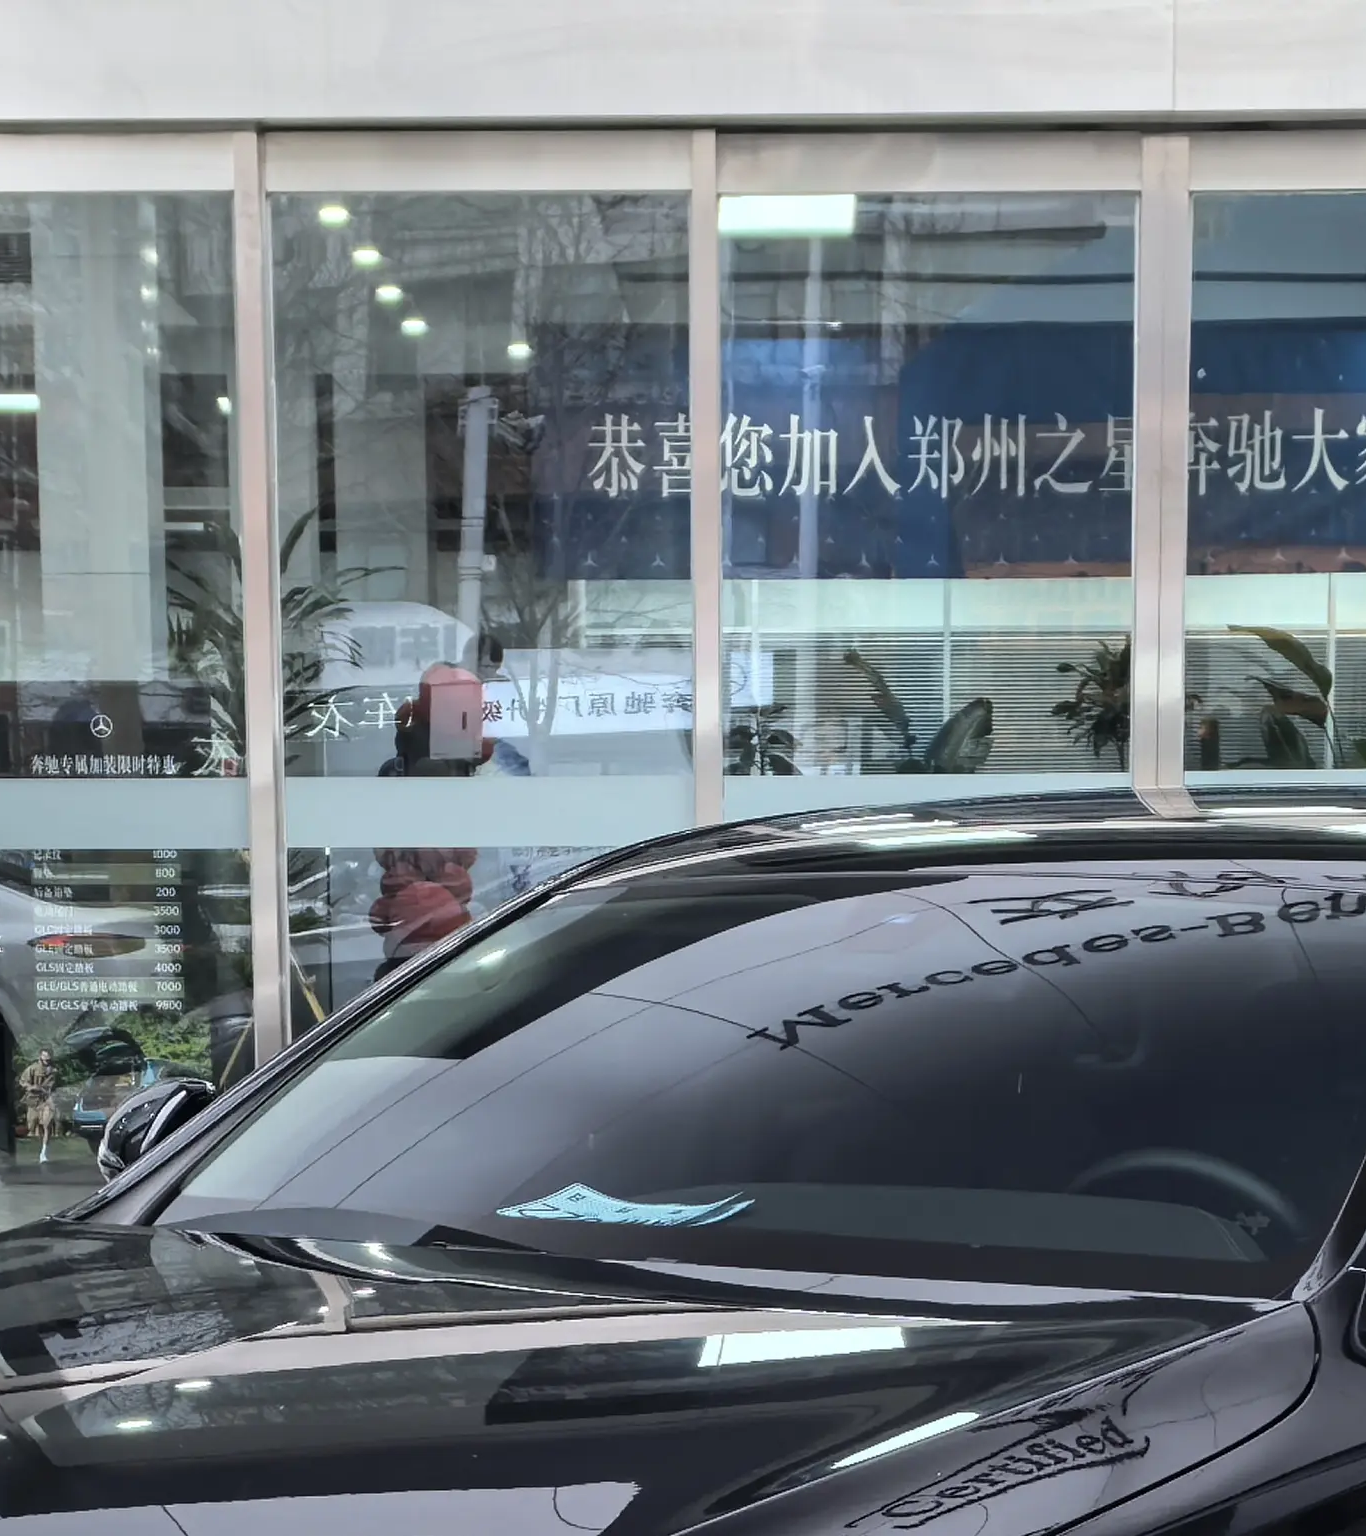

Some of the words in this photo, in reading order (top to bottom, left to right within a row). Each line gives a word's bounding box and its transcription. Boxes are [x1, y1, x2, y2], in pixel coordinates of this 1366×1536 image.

[155, 886, 176, 897] 200
[153, 905, 180, 916] 3500
[153, 924, 181, 935] 3000
[154, 943, 181, 954] 3500
[154, 962, 182, 973] 4000
[155, 981, 182, 992] 7000
